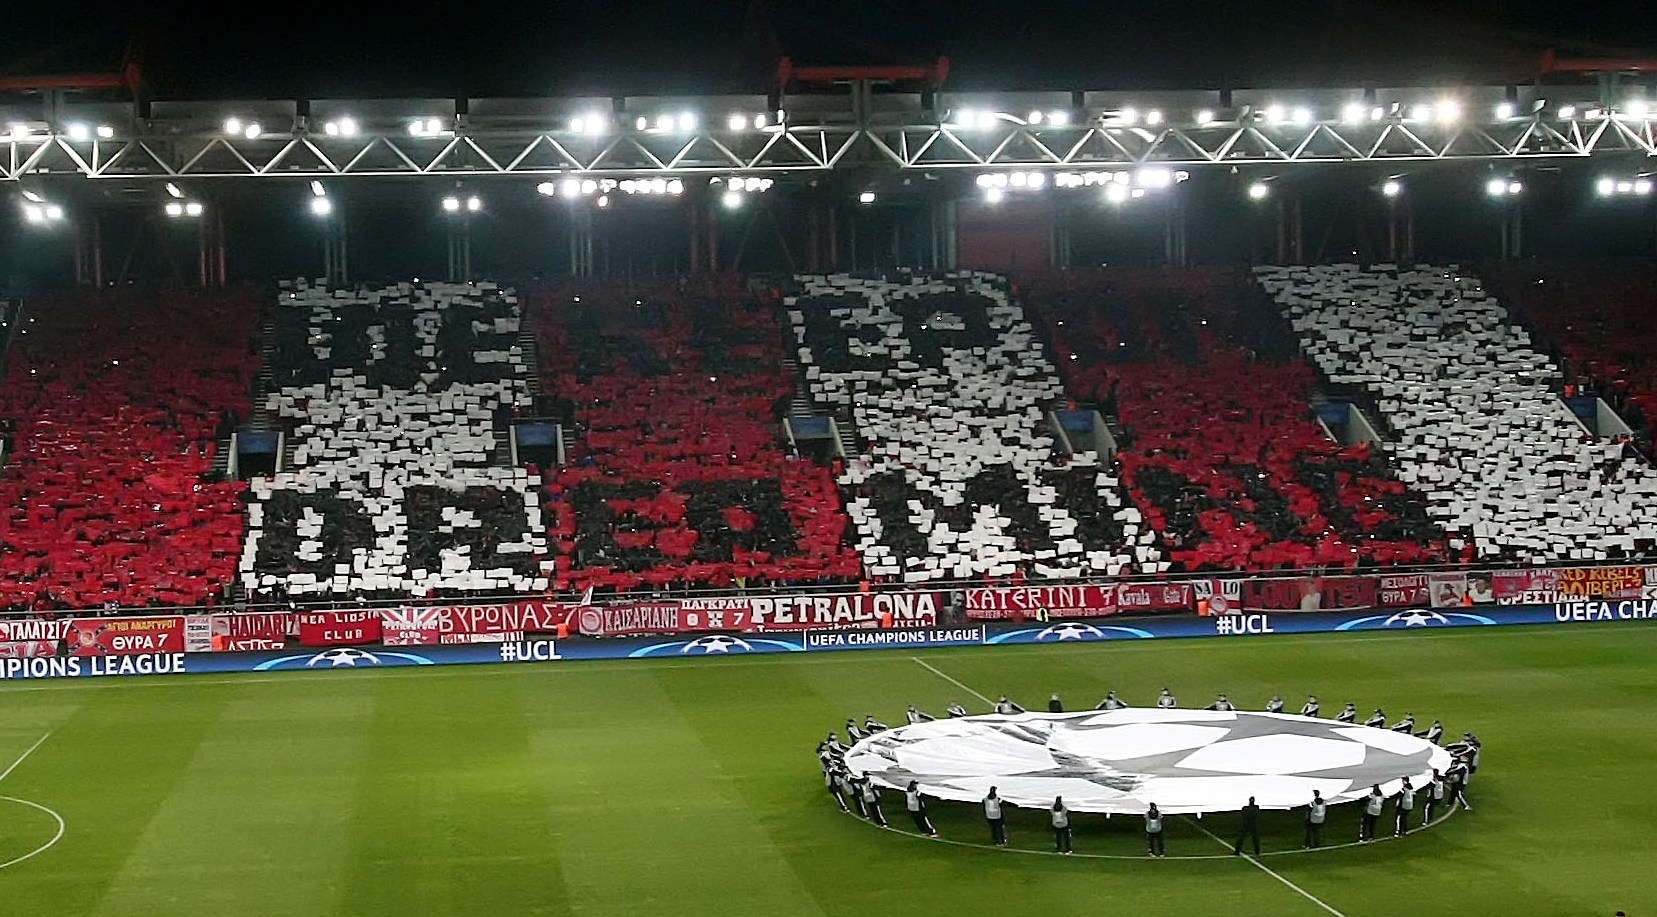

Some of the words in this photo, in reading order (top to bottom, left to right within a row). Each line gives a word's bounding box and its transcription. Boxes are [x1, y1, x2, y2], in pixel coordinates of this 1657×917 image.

[750, 593, 936, 624] PETRALONA
[965, 586, 1087, 610] KATERINI
[1555, 602, 1613, 622] UEFA
[10, 620, 60, 641] ΓΑΛΑΤΣΙ
[62, 620, 73, 640] 7
[1216, 614, 1274, 636] #UCL
[112, 635, 154, 650] ΘΥΡΑ
[157, 633, 169, 648] 7
[810, 632, 845, 647] UEFA
[847, 631, 926, 645] CHAMPIONS
[929, 628, 980, 643] LEAGUE
[499, 640, 562, 662] #UCL
[0, 655, 80, 679] PIONS
[90, 652, 187, 676] LEAGUE
